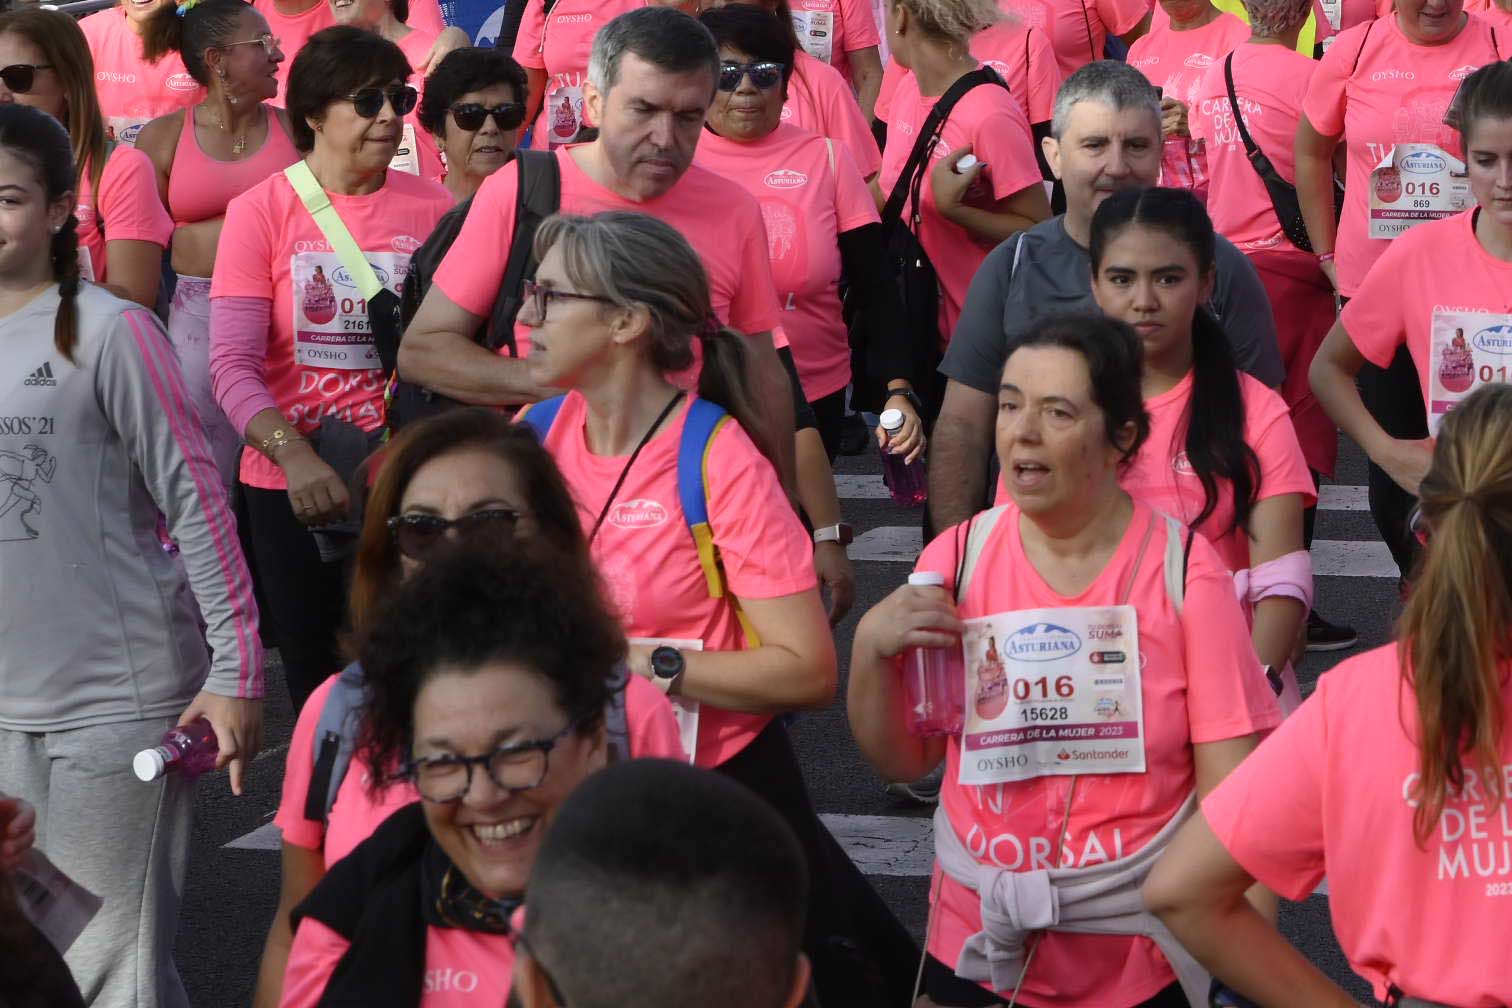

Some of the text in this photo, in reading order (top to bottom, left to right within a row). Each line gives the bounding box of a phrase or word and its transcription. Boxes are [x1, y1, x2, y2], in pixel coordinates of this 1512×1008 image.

[557, 13, 593, 24] OYSHO
[96, 71, 136, 84] OYSHO
[1372, 70, 1416, 81] OYSHO
[1404, 159, 1443, 169] ASTURIANA
[766, 173, 806, 186] ASTURIANA
[1404, 182, 1441, 196] 016
[1413, 200, 1430, 208] 869
[311, 333, 368, 343] CARRERA DE LA
[307, 350, 348, 361] OYSHO
[24, 378, 57, 387] adidas
[1088, 630, 1124, 641] SUMA
[1009, 640, 1076, 655] ASTURIANA
[1013, 675, 1075, 701] 016
[1021, 706, 1069, 722] 15628
[980, 726, 1124, 746] CARRERA DE LA MUJER 2023
[1072, 749, 1129, 761] Santander
[977, 753, 1028, 772] OYSHO
[1440, 804, 1488, 842] DE
